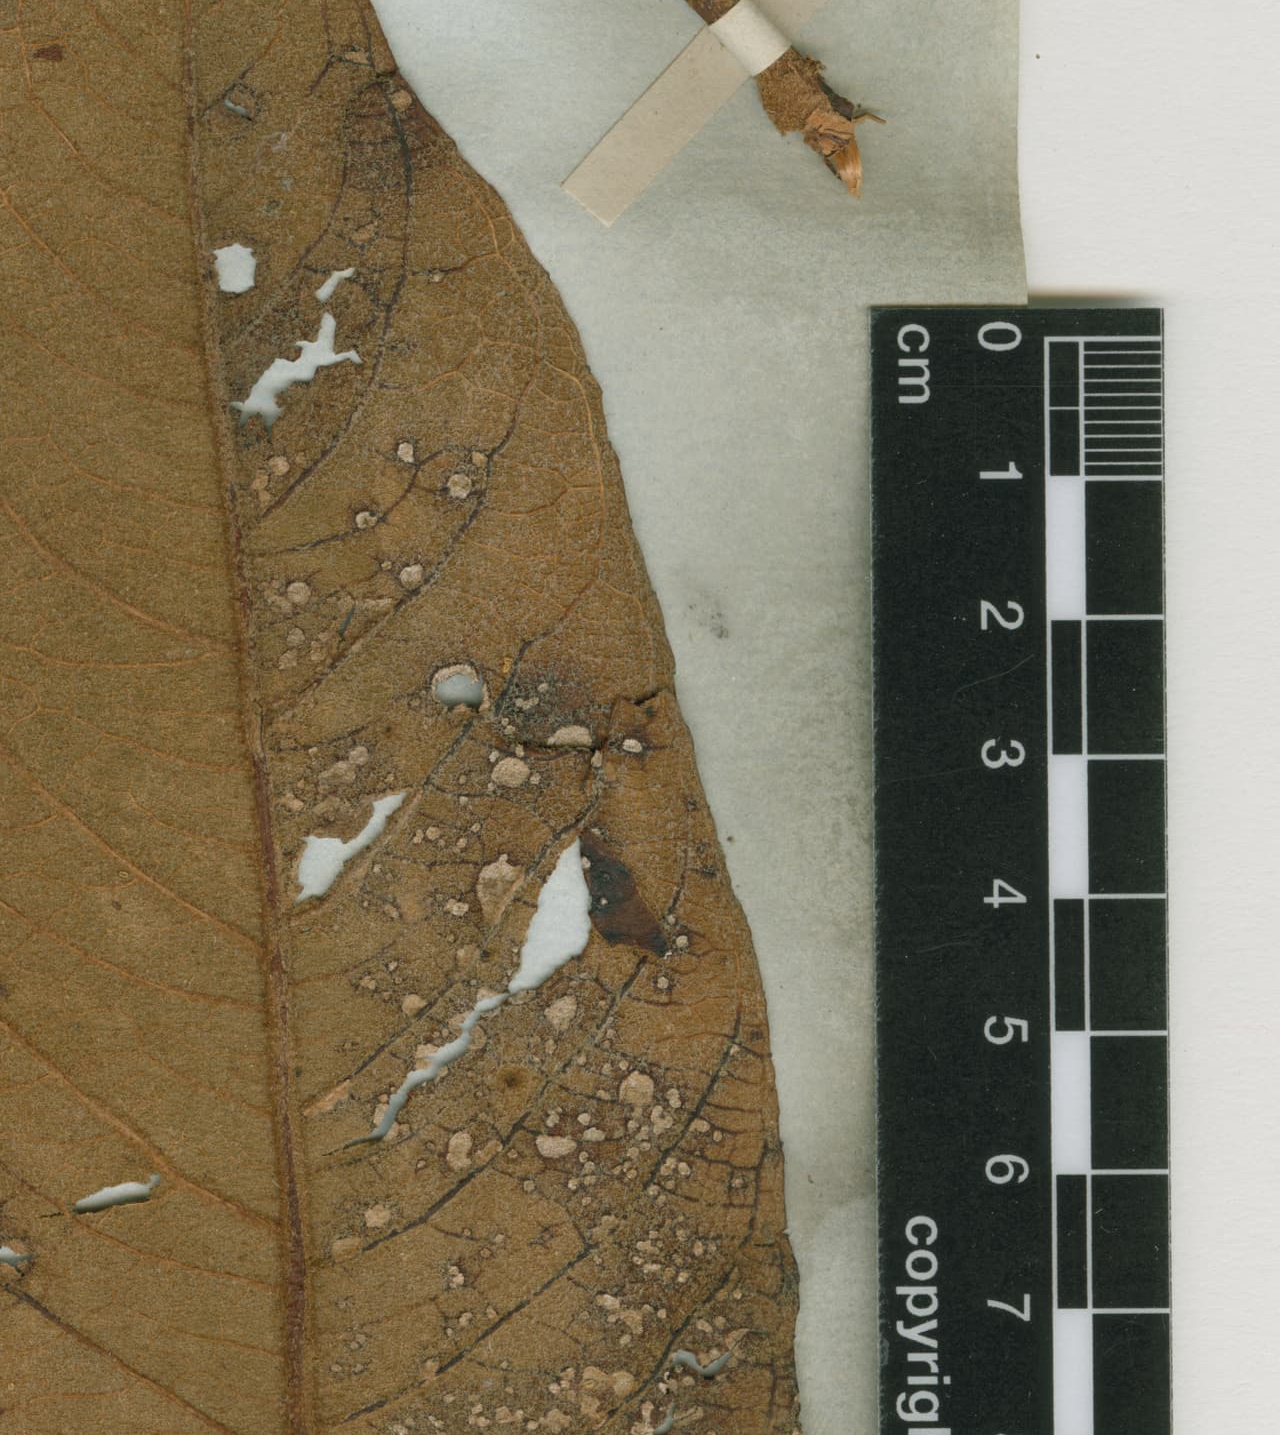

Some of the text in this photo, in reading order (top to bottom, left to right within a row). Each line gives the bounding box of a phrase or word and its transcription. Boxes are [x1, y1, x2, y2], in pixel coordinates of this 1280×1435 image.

[978, 321, 1022, 352] 0
[897, 323, 930, 404] cm
[979, 461, 1023, 480] 1
[981, 600, 1024, 631] 2
[981, 739, 1025, 769] 3
[983, 879, 1028, 908] 4
[983, 1015, 1029, 1045] 5
[985, 1154, 1030, 1185] 6
[987, 1293, 1031, 1322] 7
